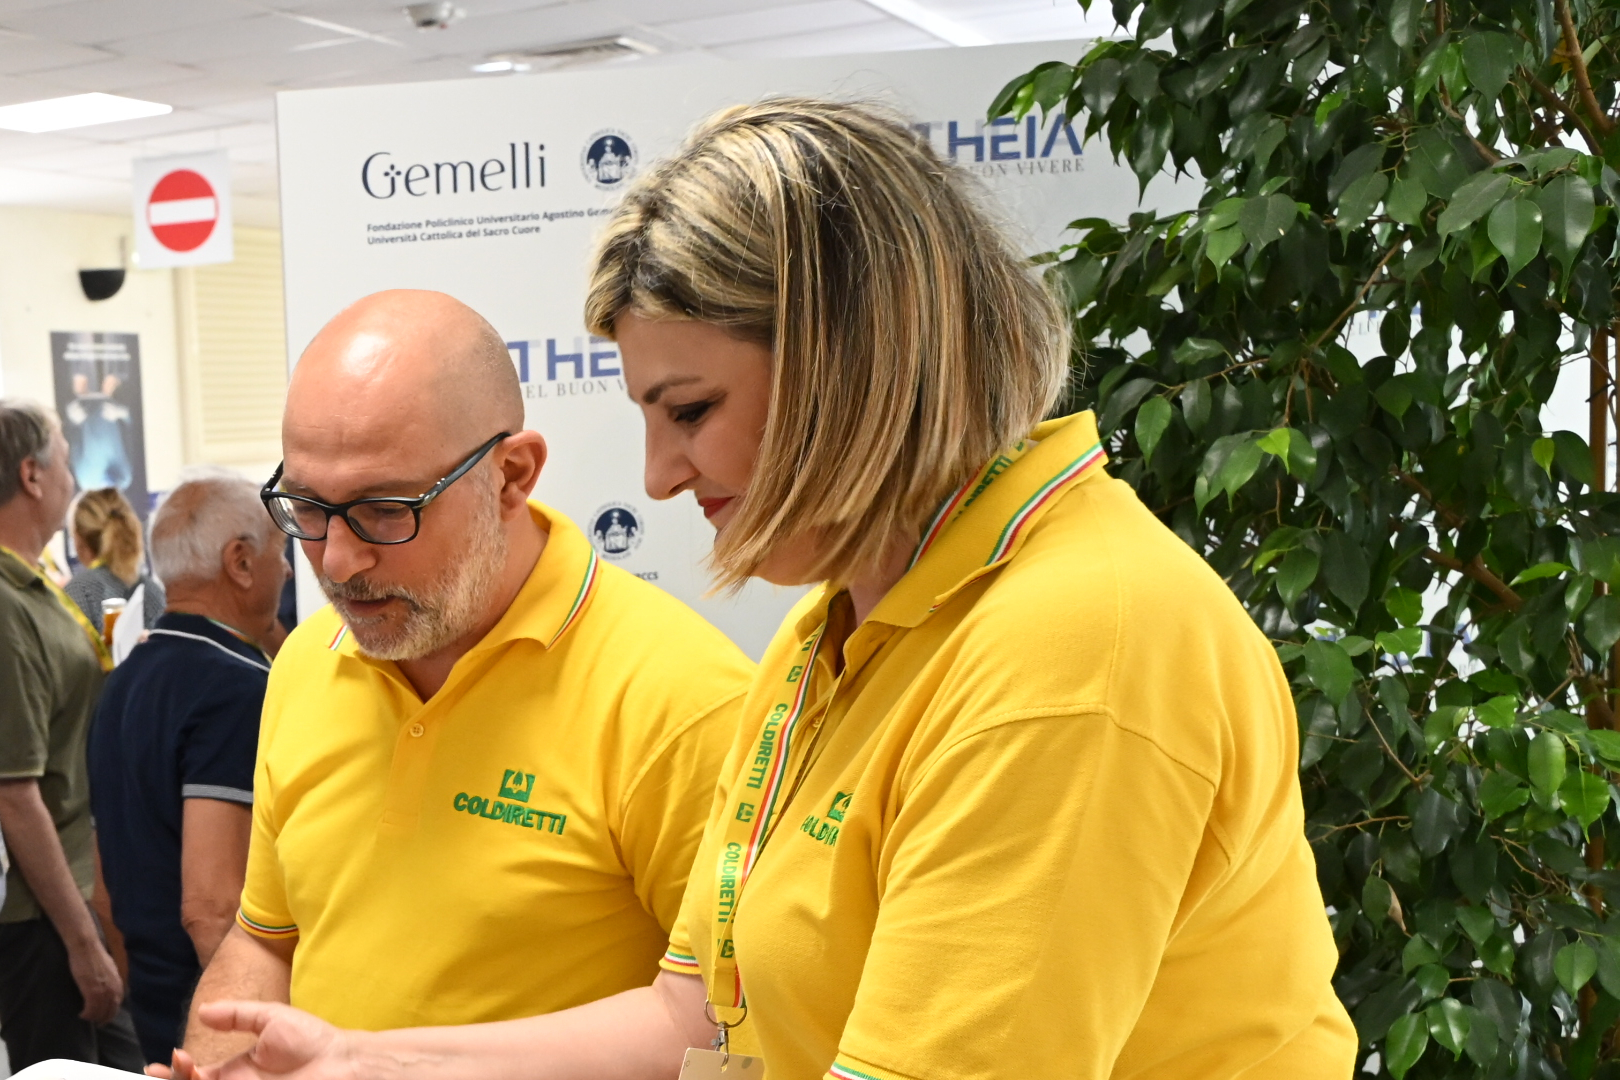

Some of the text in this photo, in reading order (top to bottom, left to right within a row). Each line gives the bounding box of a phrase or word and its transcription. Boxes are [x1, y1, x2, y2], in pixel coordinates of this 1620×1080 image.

[362, 142, 546, 200] Gemelli
[1017, 157, 1085, 176] VIVERE
[367, 220, 423, 232] Fondazione
[425, 216, 474, 228] Policlinico
[477, 212, 540, 225] Universitario
[542, 208, 584, 222] Agostino
[367, 224, 541, 245] Università Cattolica del Sacro Cuore
[526, 384, 548, 400] EL
[556, 380, 608, 397] BUON
[746, 703, 789, 789] COLDIRETTI
[453, 792, 567, 835] COLDIRETTI
[718, 841, 742, 923] COLDIRETTI
